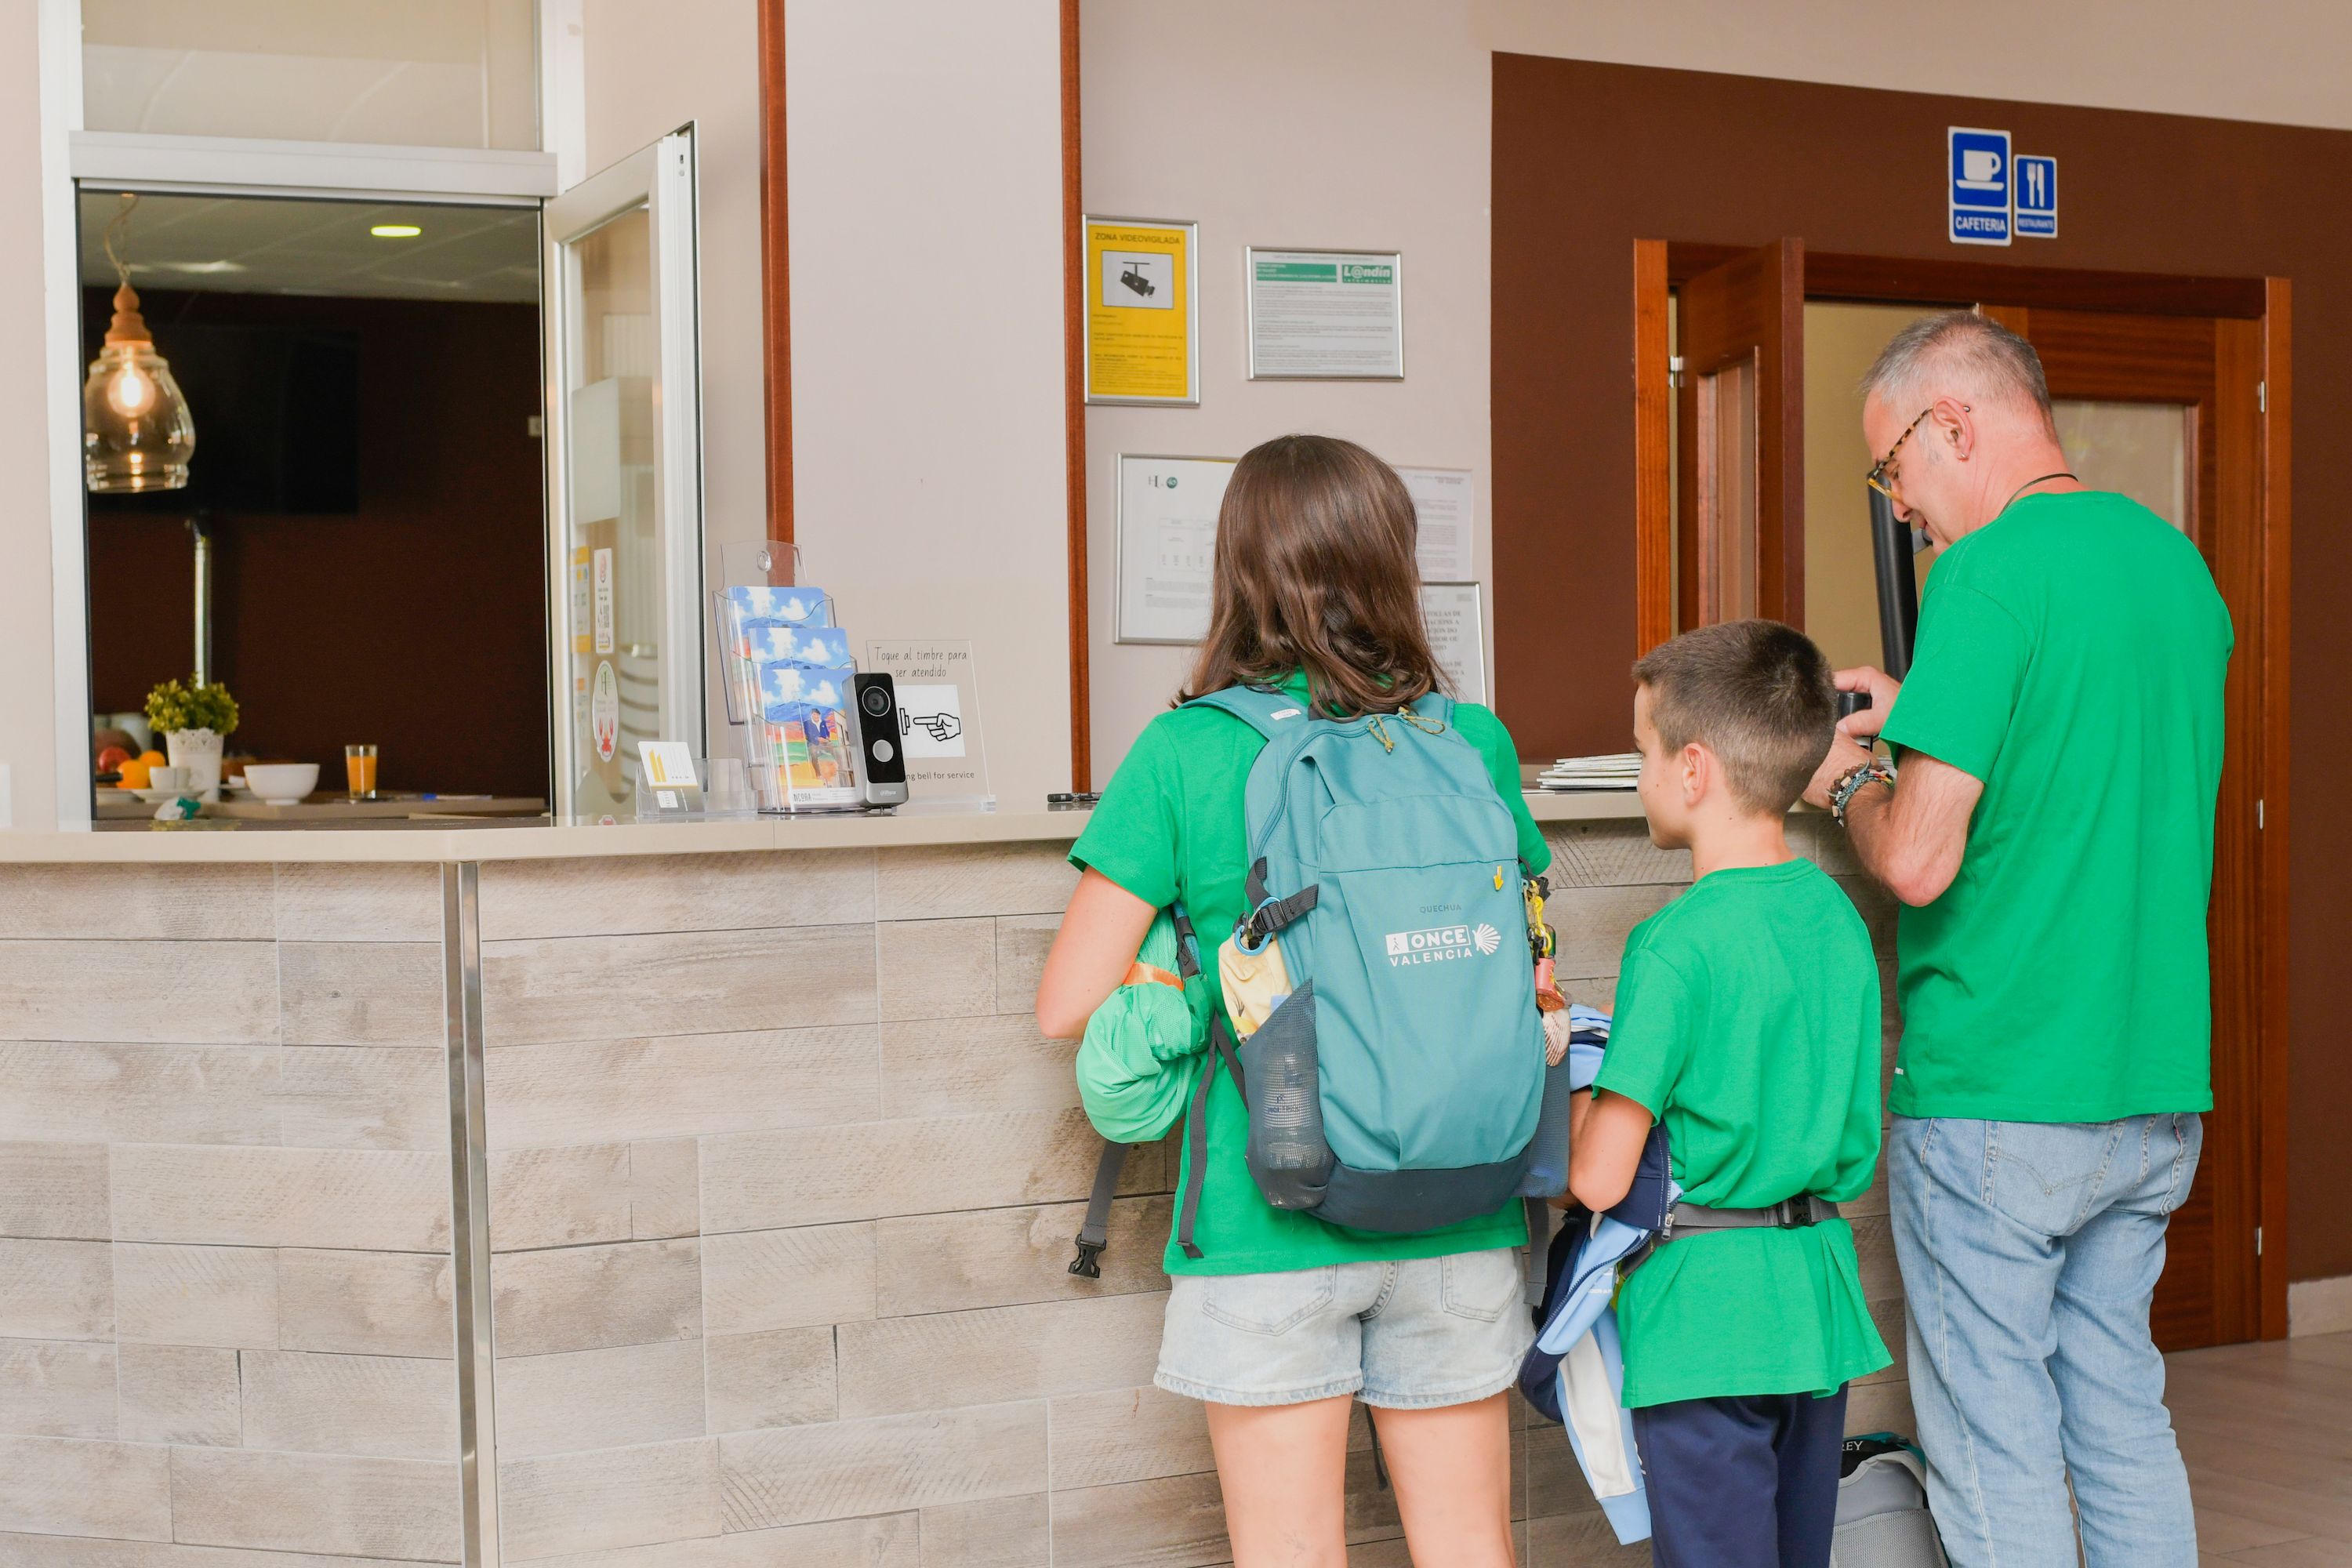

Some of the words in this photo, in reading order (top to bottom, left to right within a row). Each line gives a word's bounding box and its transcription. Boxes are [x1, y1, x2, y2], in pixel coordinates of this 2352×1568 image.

[1955, 216, 2006, 232] CAFETERIA
[1095, 232, 1117, 241] ZONA
[1120, 234, 1180, 244] VIDEOVIGILADA
[874, 647, 899, 664] Toque
[904, 648, 912, 660] al
[916, 647, 943, 660] timbre
[948, 652, 967, 666] para
[912, 664, 946, 677] atendido
[1419, 904, 1462, 913] QUECHUA
[1410, 928, 1467, 949] ONCE
[1389, 948, 1472, 967] VALENCIA
